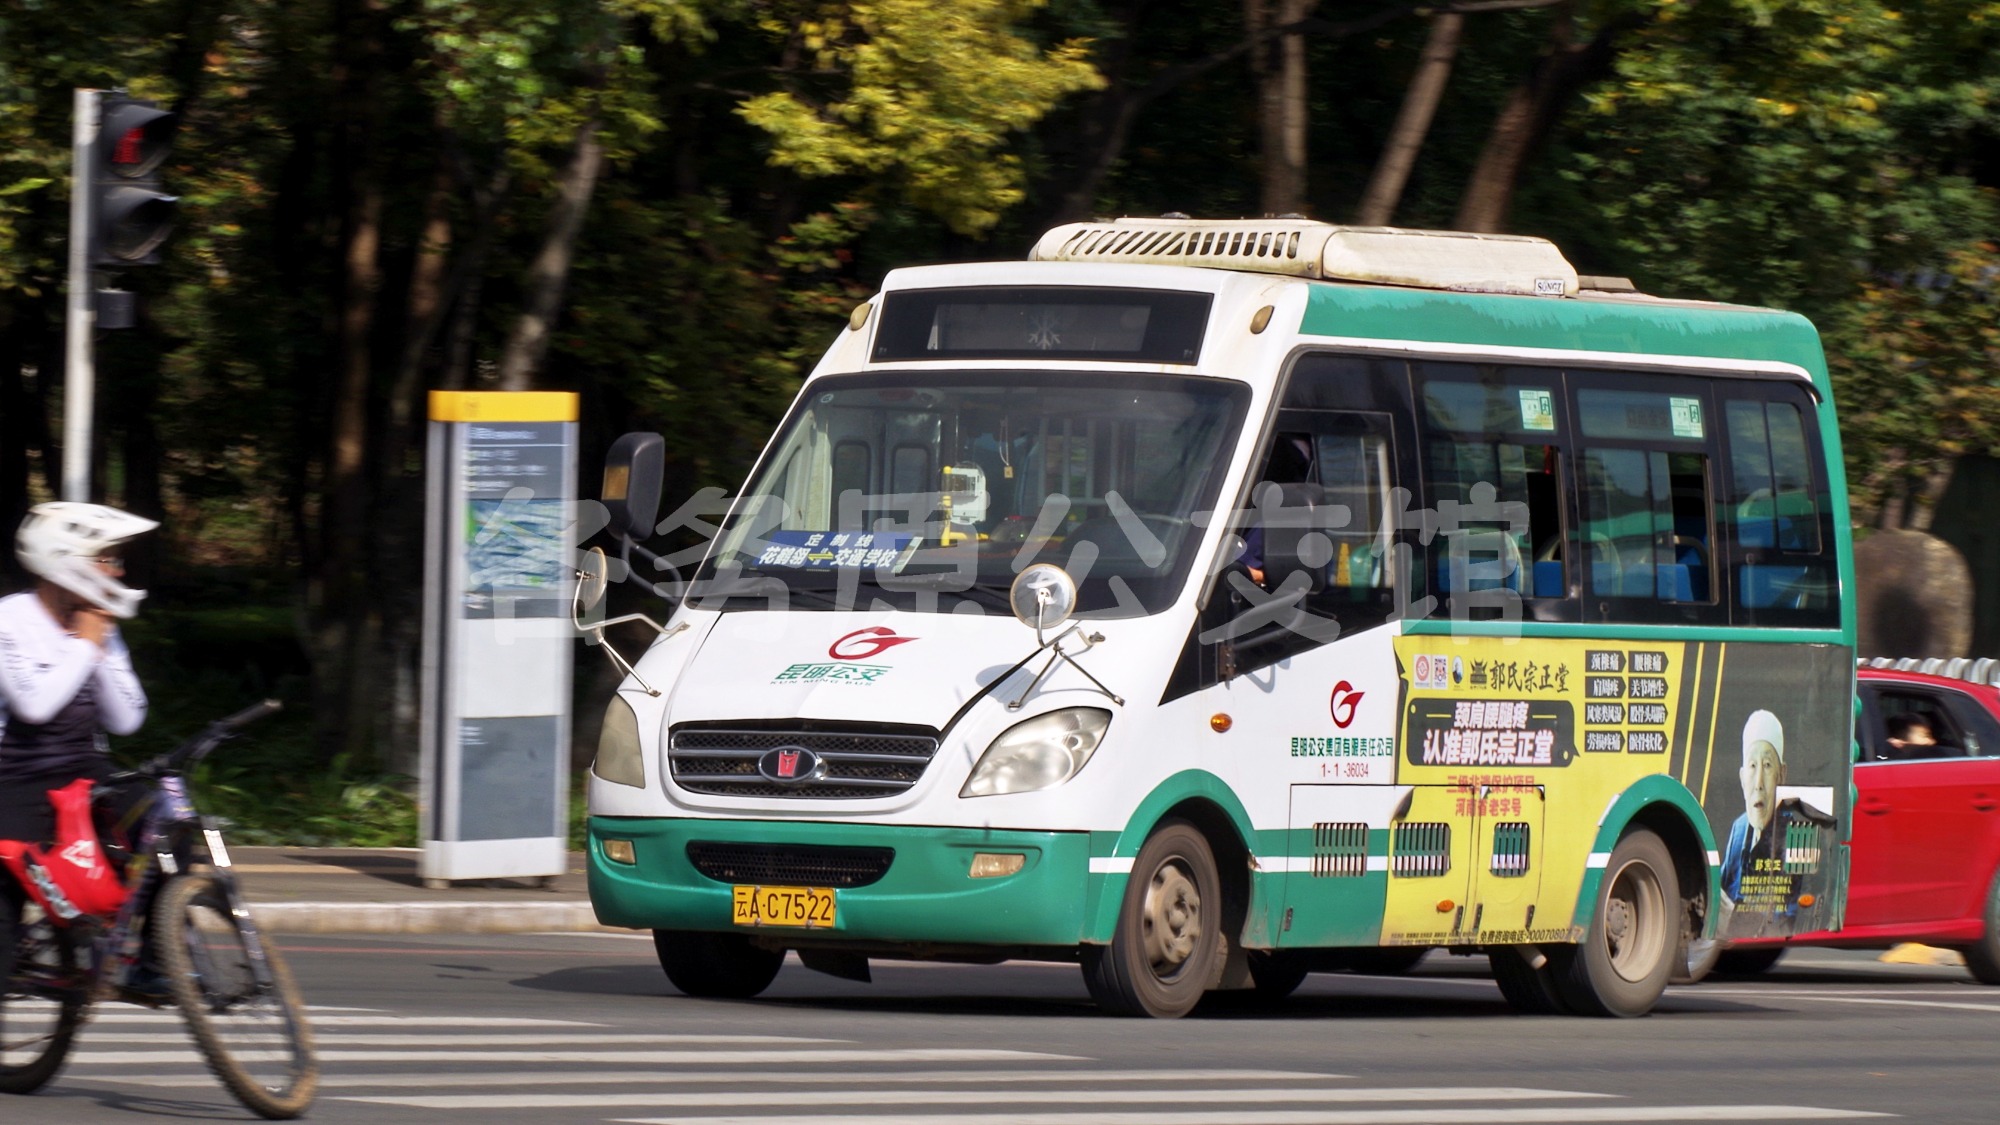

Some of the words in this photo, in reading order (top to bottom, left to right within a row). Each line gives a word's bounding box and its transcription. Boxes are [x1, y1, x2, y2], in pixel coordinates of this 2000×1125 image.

[804, 533, 874, 548] 定制线
[829, 548, 899, 568] 交通学校
[775, 662, 891, 682] 昆明公交
[1591, 653, 1619, 671] 颈椎痛
[1634, 653, 1662, 672] 腰椎痛
[1490, 659, 1570, 693] 郭氏宗正堂
[1631, 679, 1664, 697] 关节增生
[1454, 701, 1529, 729] 颈肩腰腿疼
[1291, 737, 1394, 757] 昆明公交集团有限责任公司
[1423, 729, 1554, 765] 认准郭氏宗正堂
[1455, 797, 1521, 817] 河南省老字号
